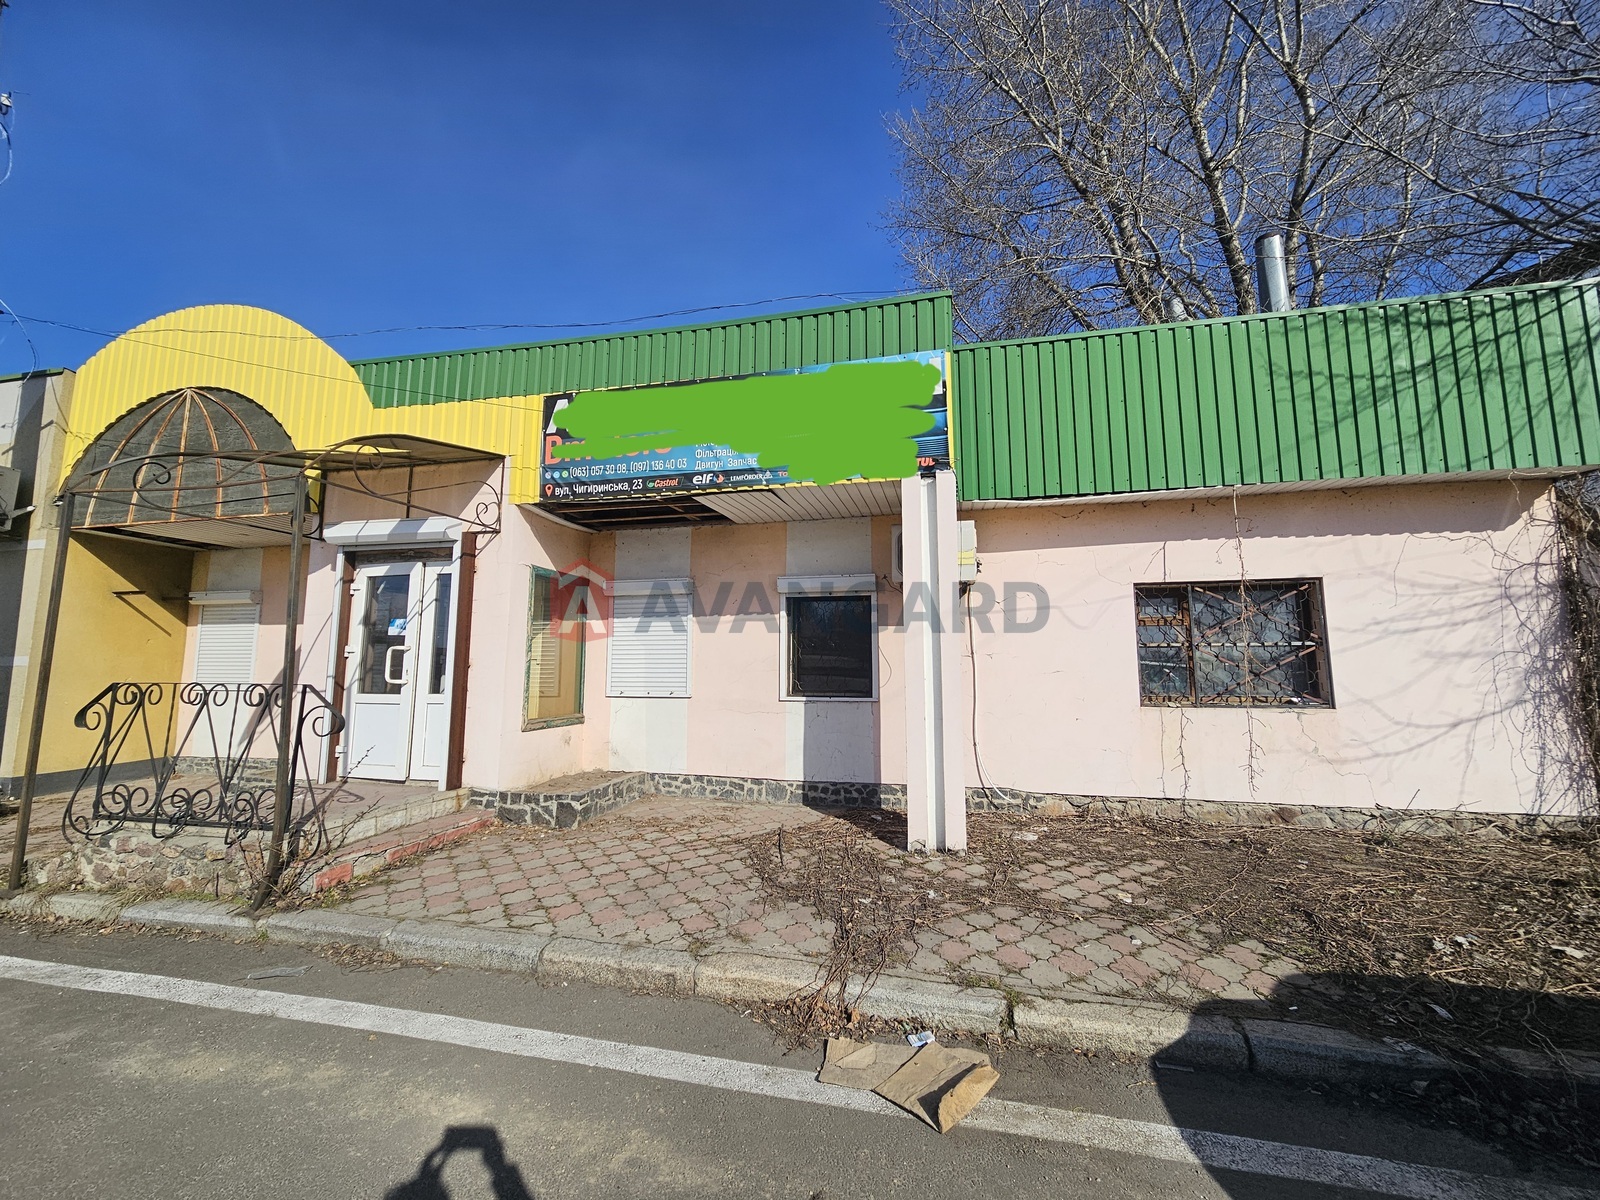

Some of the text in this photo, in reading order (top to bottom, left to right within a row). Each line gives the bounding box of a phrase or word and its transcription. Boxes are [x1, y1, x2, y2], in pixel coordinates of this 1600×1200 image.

[695, 449, 739, 459] Фільтрац
[569, 458, 688, 479] (063) 057 30 08, (097) 136 40 03
[695, 457, 757, 471] Двигун Запчас
[654, 478, 679, 488] Castrol
[692, 473, 714, 484] elf
[554, 479, 643, 497] вул. Чигиринська, 23
